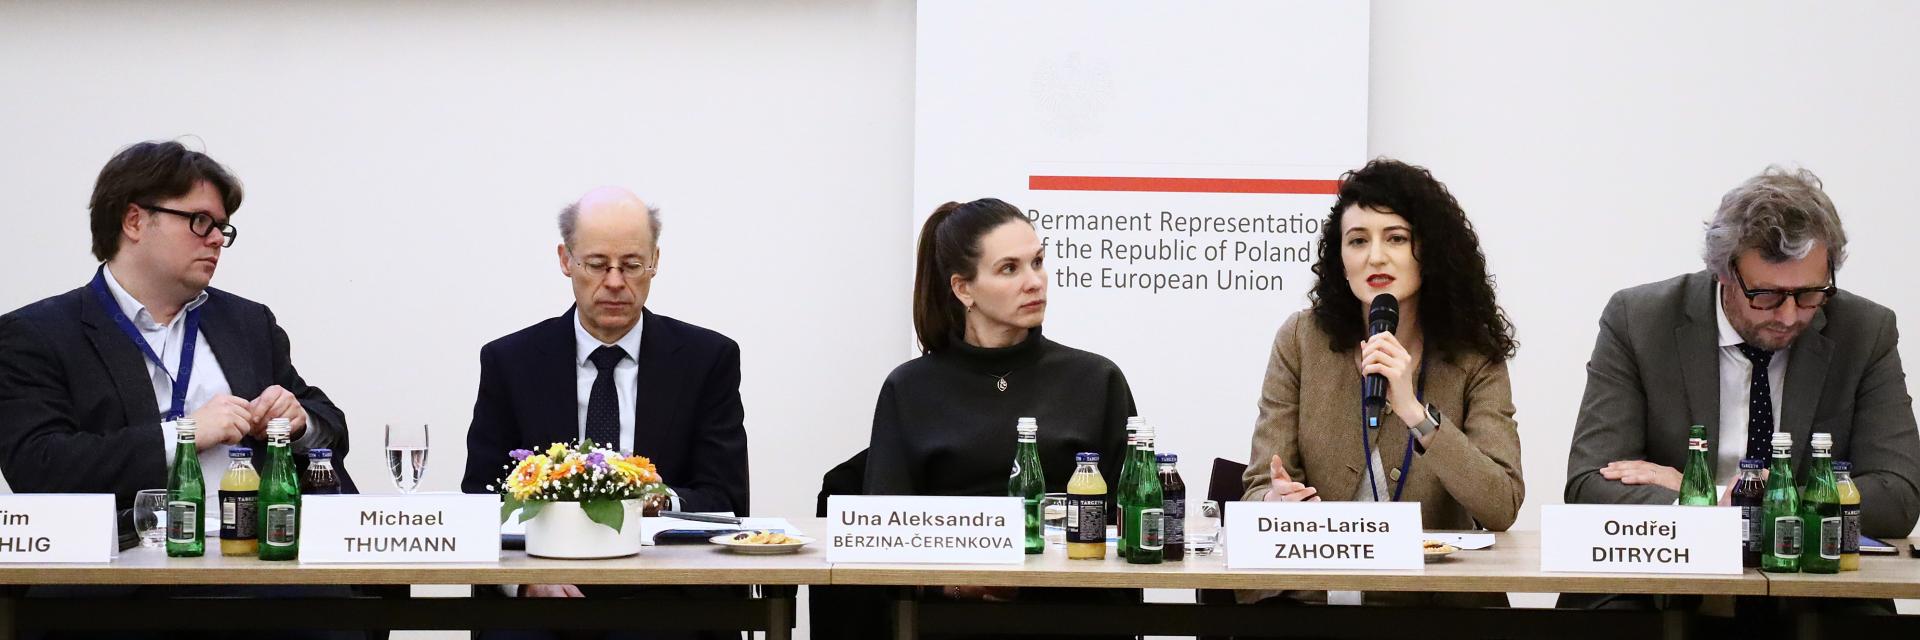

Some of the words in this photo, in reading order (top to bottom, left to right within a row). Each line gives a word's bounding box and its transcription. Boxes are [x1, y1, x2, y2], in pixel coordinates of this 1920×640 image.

[1028, 209, 1152, 232] Permanent
[1041, 236, 1050, 259] f
[1055, 236, 1092, 260] the
[1101, 237, 1197, 265] Republic
[1205, 240, 1228, 262] of
[1236, 241, 1311, 264] Poland
[1055, 265, 1093, 288] the
[1101, 267, 1208, 295] European
[1217, 269, 1283, 291] Union
[0, 510, 29, 526] im
[360, 510, 444, 526] Michael
[842, 510, 882, 526] Una
[888, 510, 1005, 527] Aleksandra
[1258, 517, 1390, 533] Diana-Larisa
[1604, 520, 1677, 540] Ondřej
[344, 537, 456, 553] THUMANN
[1275, 543, 1375, 559] ZAHORTE
[1592, 546, 1689, 564] DITRYCH
